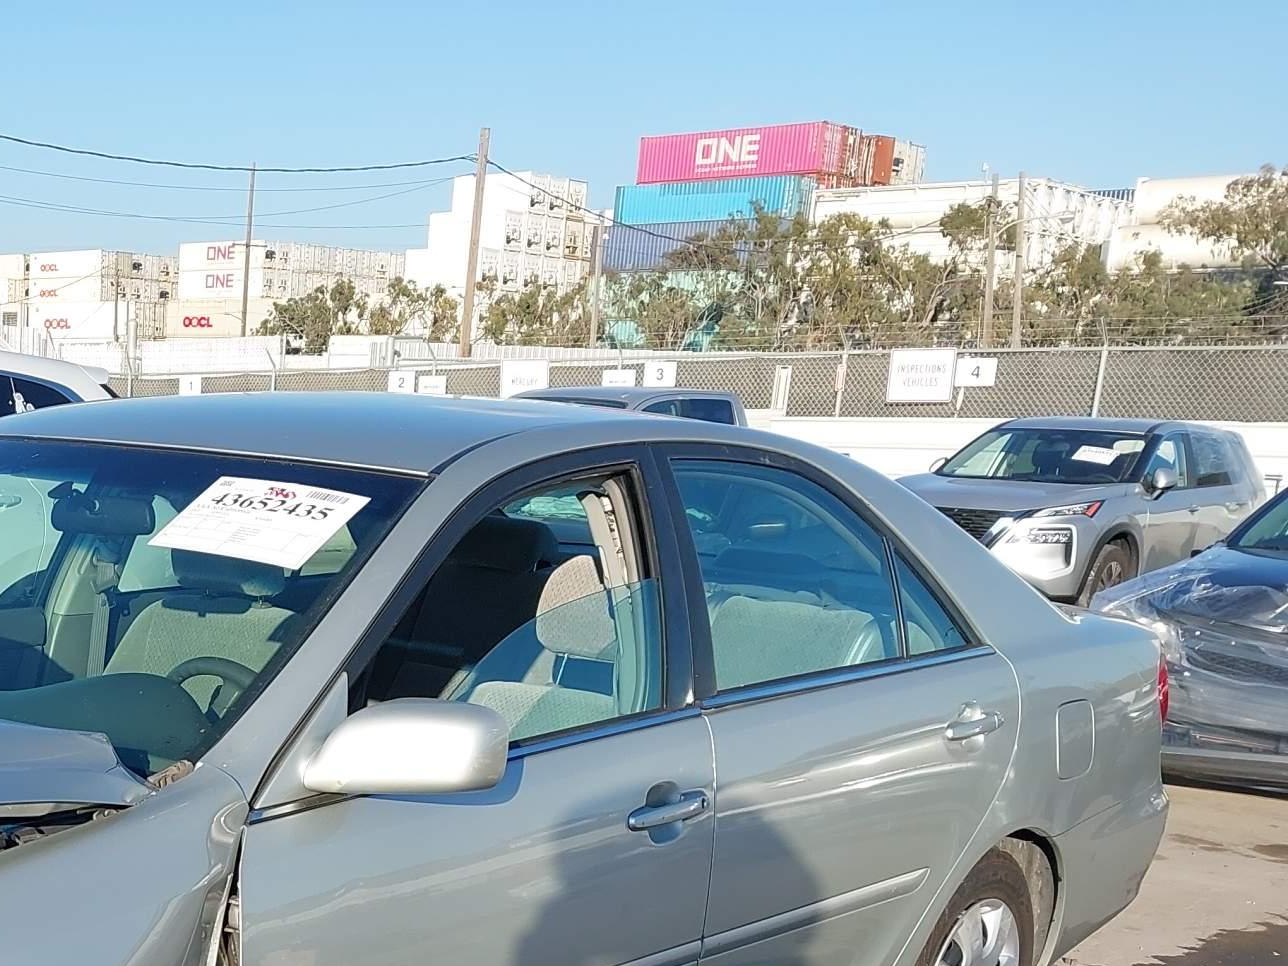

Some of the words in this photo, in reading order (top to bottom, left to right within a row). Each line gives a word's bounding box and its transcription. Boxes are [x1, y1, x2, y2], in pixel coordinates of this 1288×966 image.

[696, 134, 760, 164] ONE
[207, 246, 235, 260] ONE
[40, 264, 59, 272] OOCL
[205, 274, 234, 288] ONE
[40, 289, 58, 297] OOCL
[44, 319, 71, 329] OOCL
[183, 316, 213, 328] OOCL
[656, 368, 664, 381] 3
[971, 365, 980, 379] 4
[398, 377, 405, 388] 2
[211, 492, 335, 520] 43652435
